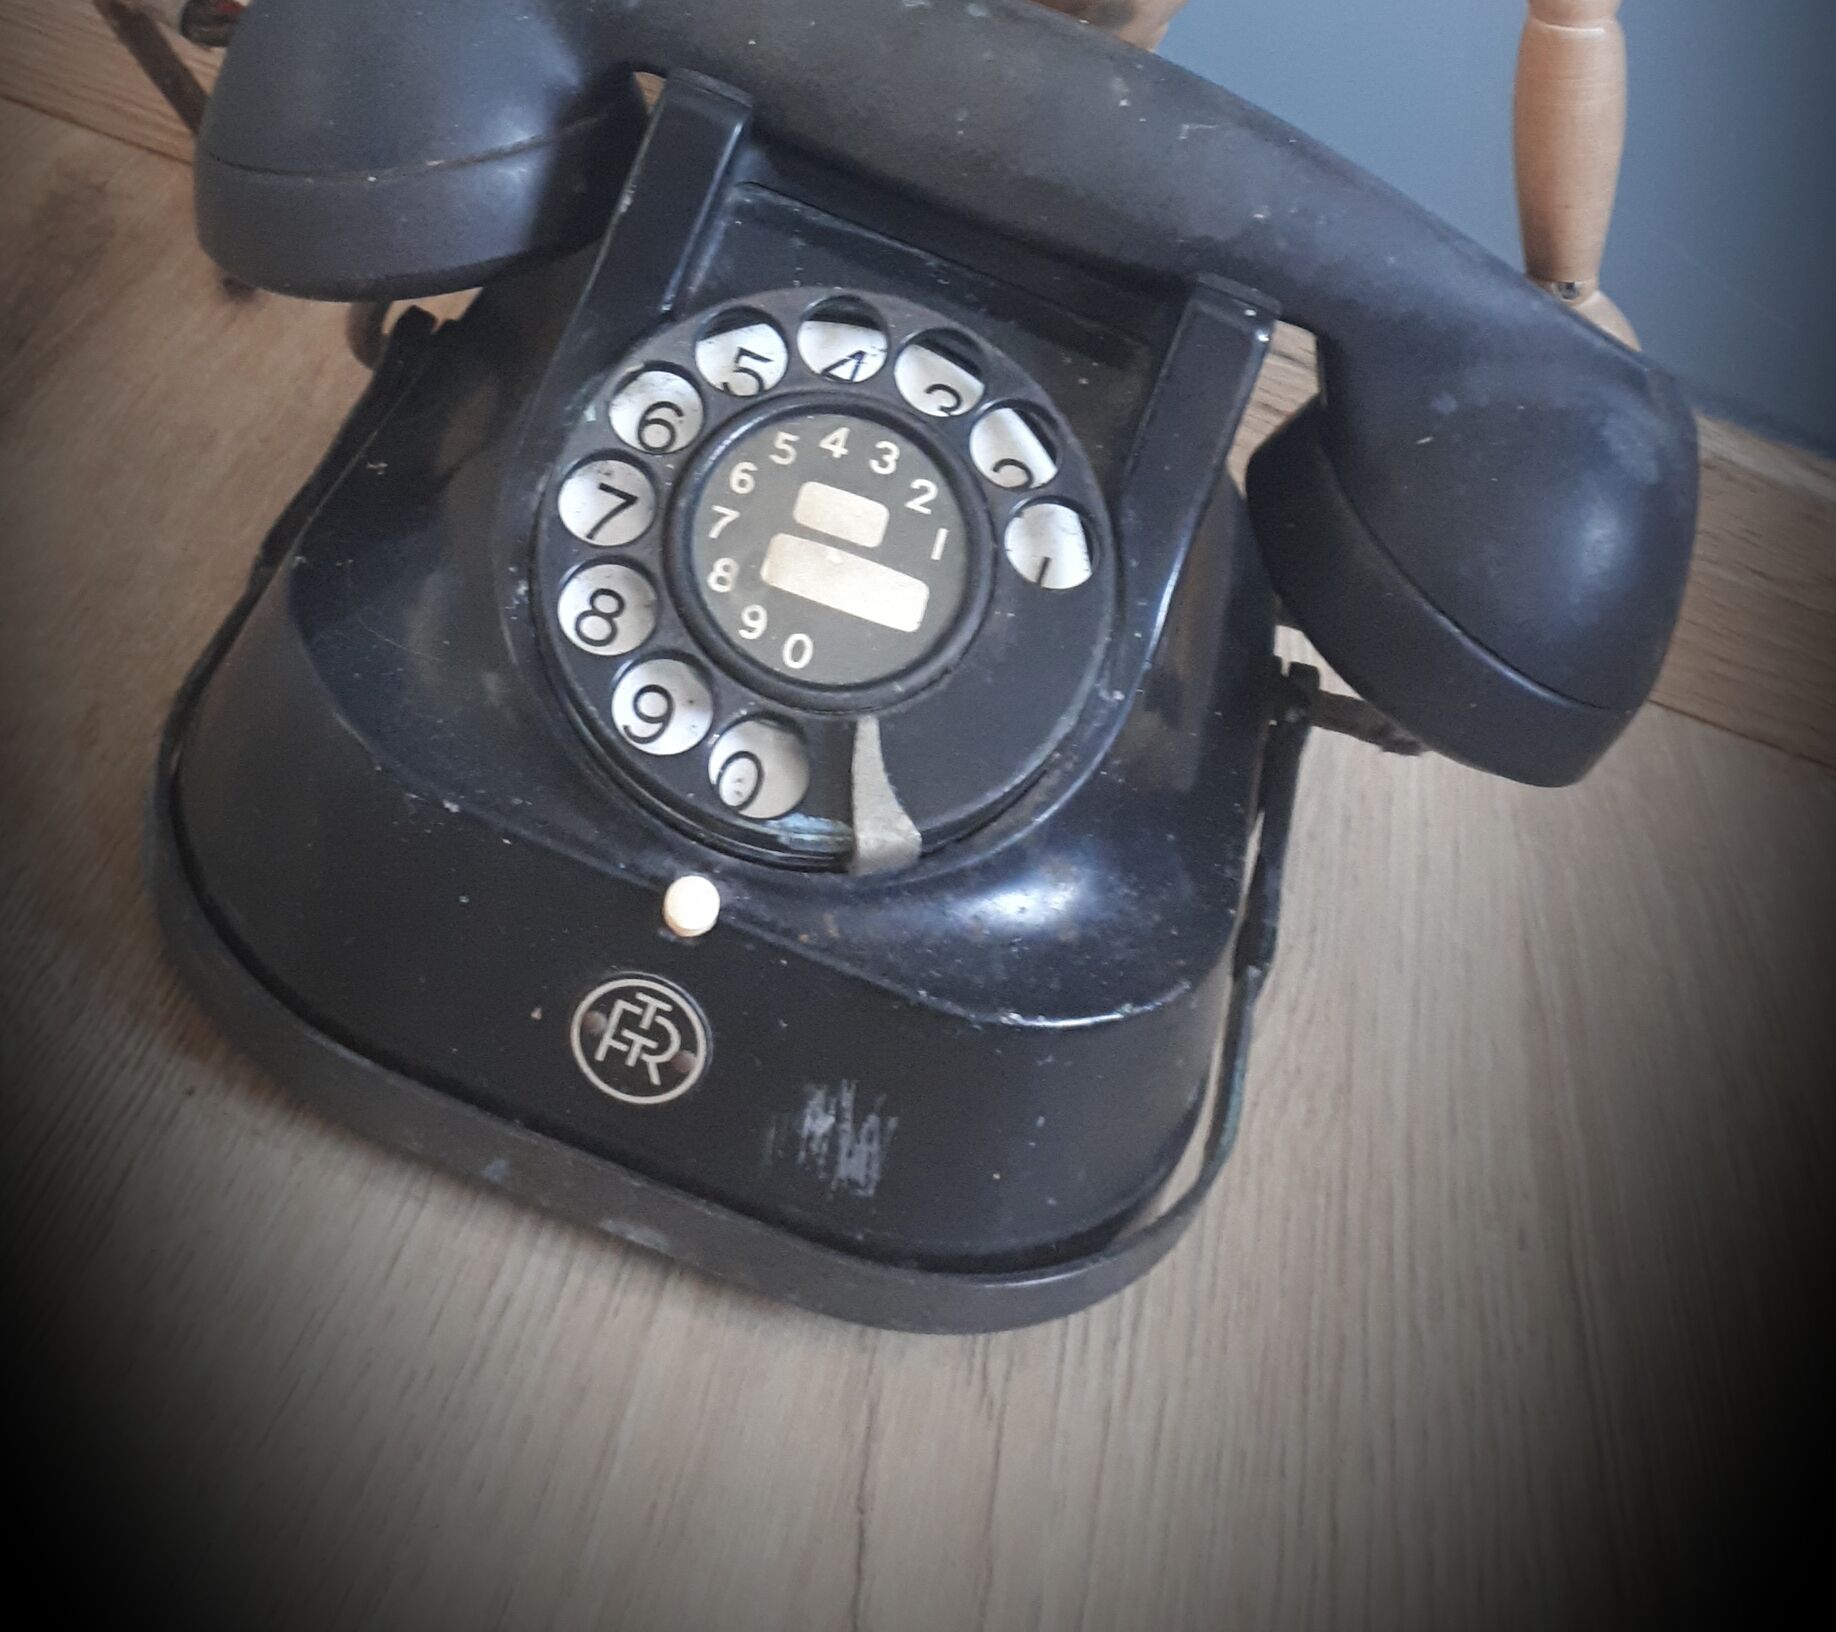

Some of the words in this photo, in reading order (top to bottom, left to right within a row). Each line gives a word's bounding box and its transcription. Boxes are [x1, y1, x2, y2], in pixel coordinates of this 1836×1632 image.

[722, 347, 773, 396] 5
[638, 401, 685, 454] 6
[819, 427, 850, 458] 4
[768, 431, 799, 465] 5
[869, 441, 899, 475] 3
[729, 462, 758, 494] 6
[586, 483, 639, 540] 7
[905, 479, 938, 514] 2
[708, 505, 740, 539] 7
[930, 528, 949, 560] 1
[707, 558, 739, 592] 8
[575, 588, 625, 647] 8
[738, 604, 767, 639] 9
[782, 633, 814, 669] 0
[623, 684, 674, 744] 9
[716, 750, 765, 811] 0
